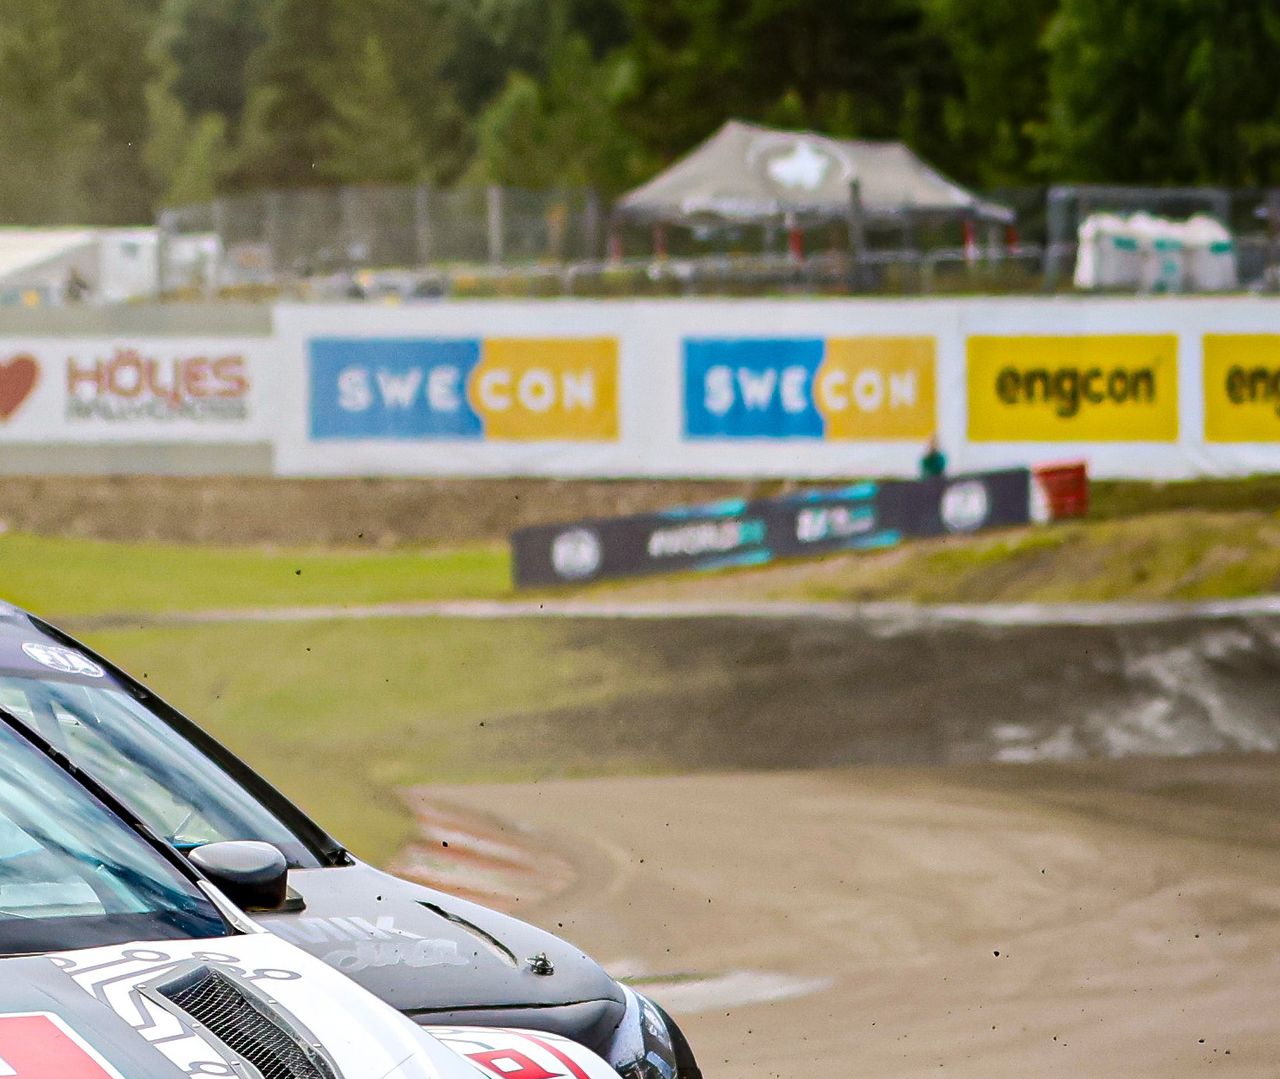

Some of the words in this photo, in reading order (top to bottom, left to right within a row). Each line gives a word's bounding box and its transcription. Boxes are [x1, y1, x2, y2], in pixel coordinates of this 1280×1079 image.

[338, 366, 596, 412] SWECON
[704, 365, 917, 415] SWECON
[996, 366, 1155, 418] engcon
